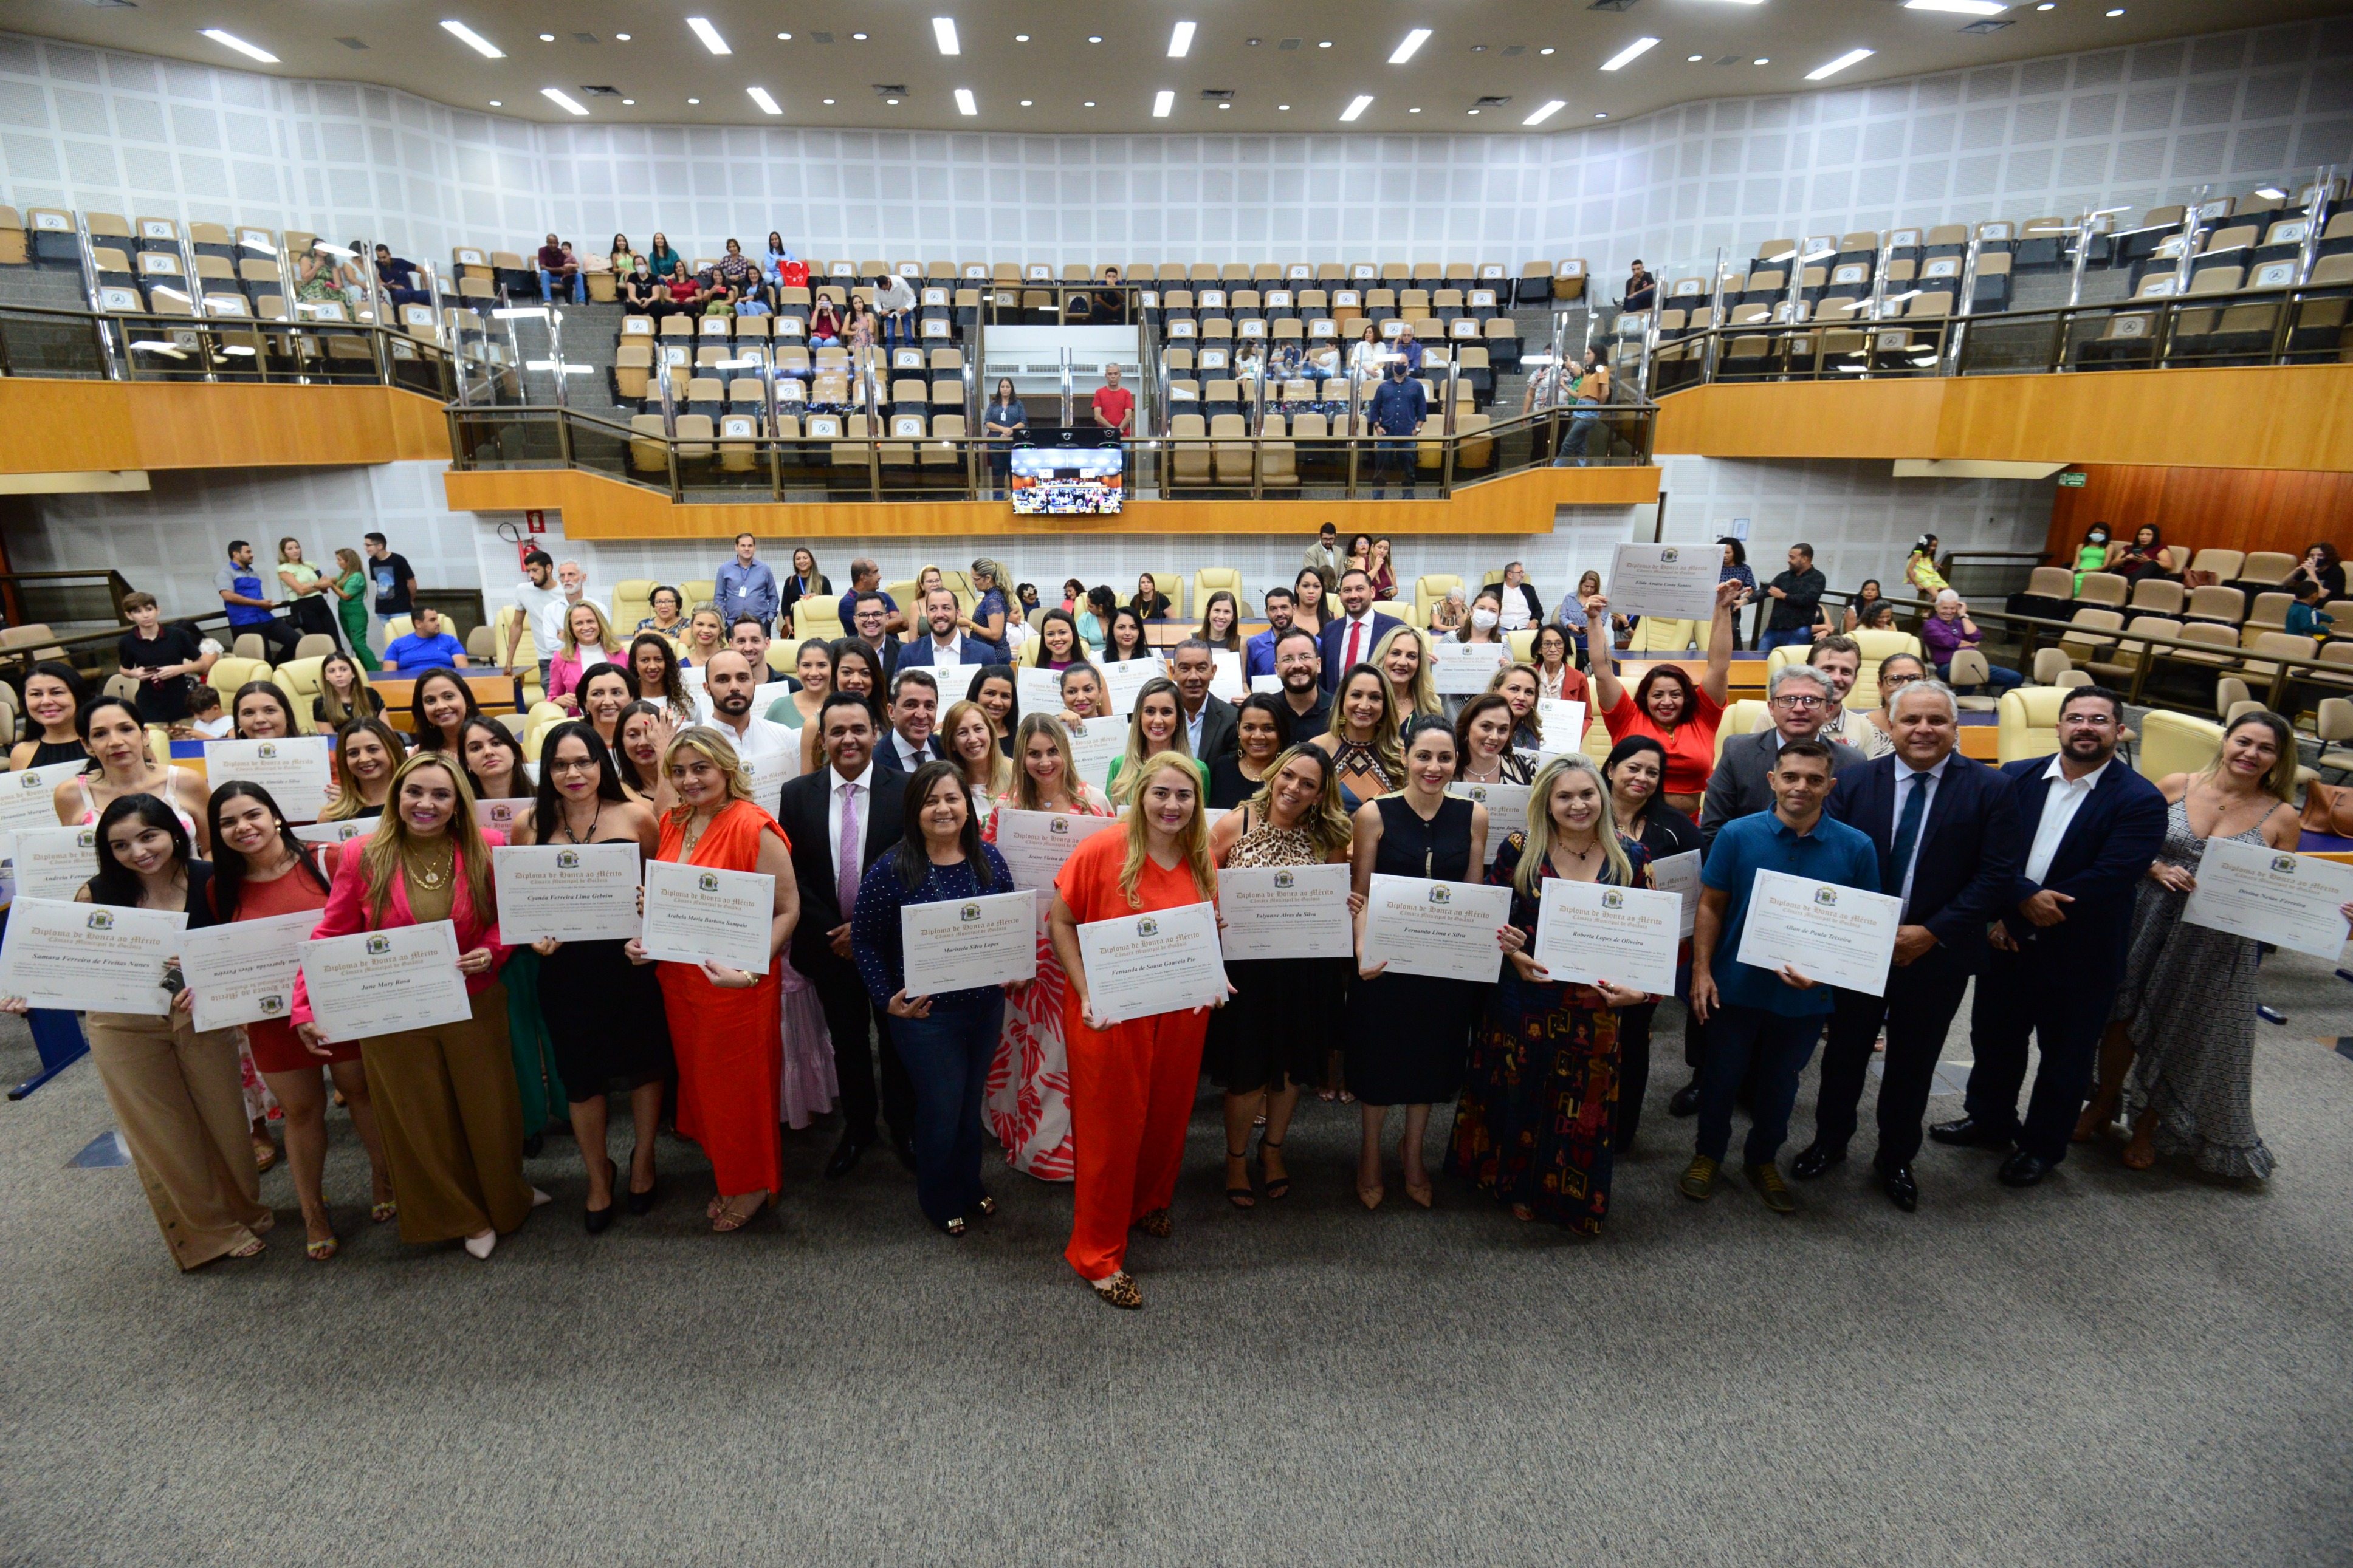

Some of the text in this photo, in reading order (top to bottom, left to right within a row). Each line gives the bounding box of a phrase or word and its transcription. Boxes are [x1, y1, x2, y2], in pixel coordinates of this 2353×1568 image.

[661, 888, 688, 897] Diploma
[700, 893, 720, 902] Honra
[732, 898, 754, 907] Mérito
[1387, 901, 1416, 910] Diploma
[1429, 906, 1451, 914] Honra
[1464, 910, 1489, 918] Mérito
[1559, 905, 1589, 915] Diploma
[1602, 910, 1624, 920] Honra
[1637, 916, 1662, 925] Mérito
[1769, 897, 1800, 909] Diploma
[1813, 906, 1837, 917] Honra
[1850, 915, 1876, 925] Mérito
[31, 927, 70, 937] Diploma
[86, 932, 114, 941] Honra
[130, 936, 160, 945] Mérito
[1099, 945, 1129, 954] Diploma
[1176, 933, 1199, 941] Mérito
[1828, 934, 1851, 943] Teixeira
[323, 963, 357, 972] Diploma
[411, 950, 437, 959] Mérito
[1112, 967, 1137, 975] Fernanda
